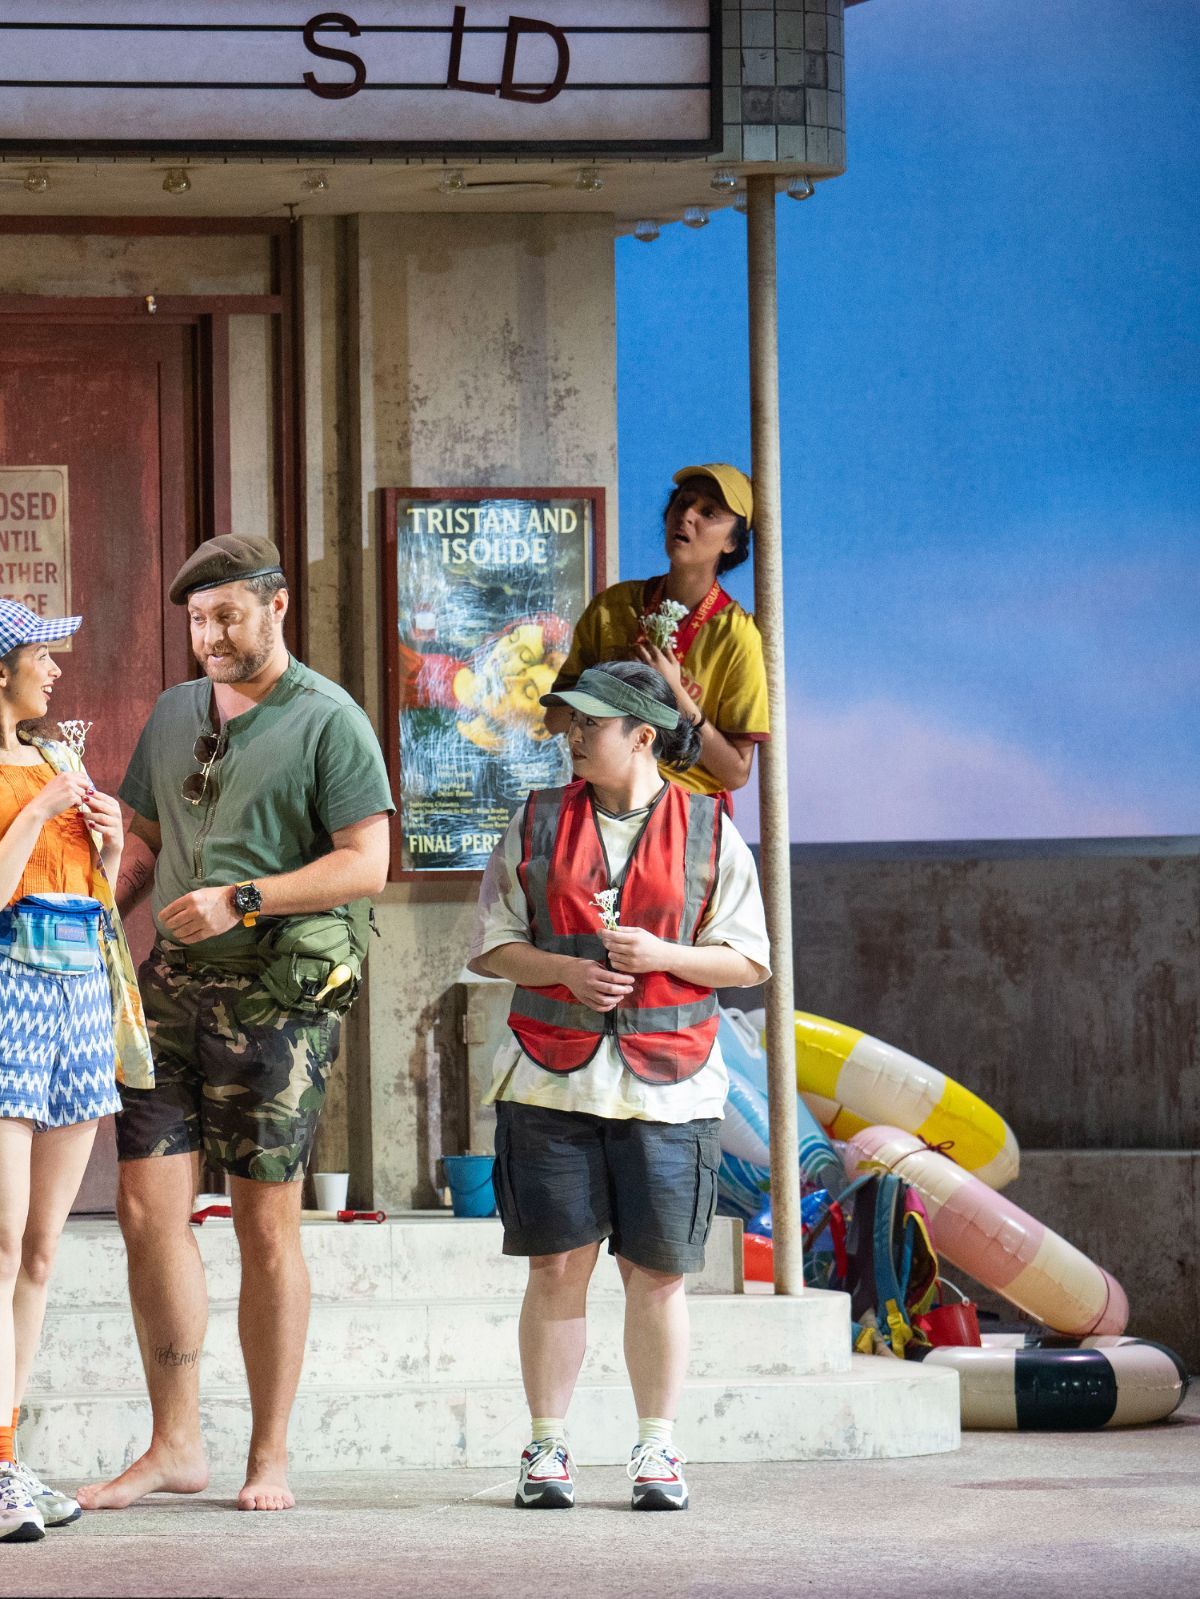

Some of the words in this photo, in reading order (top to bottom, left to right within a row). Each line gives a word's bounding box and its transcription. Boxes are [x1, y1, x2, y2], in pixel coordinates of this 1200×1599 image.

[406, 507, 520, 534] TRISTAN
[526, 507, 578, 534] AND
[441, 537, 548, 565] ISOLDE
[408, 834, 457, 854] FINAL
